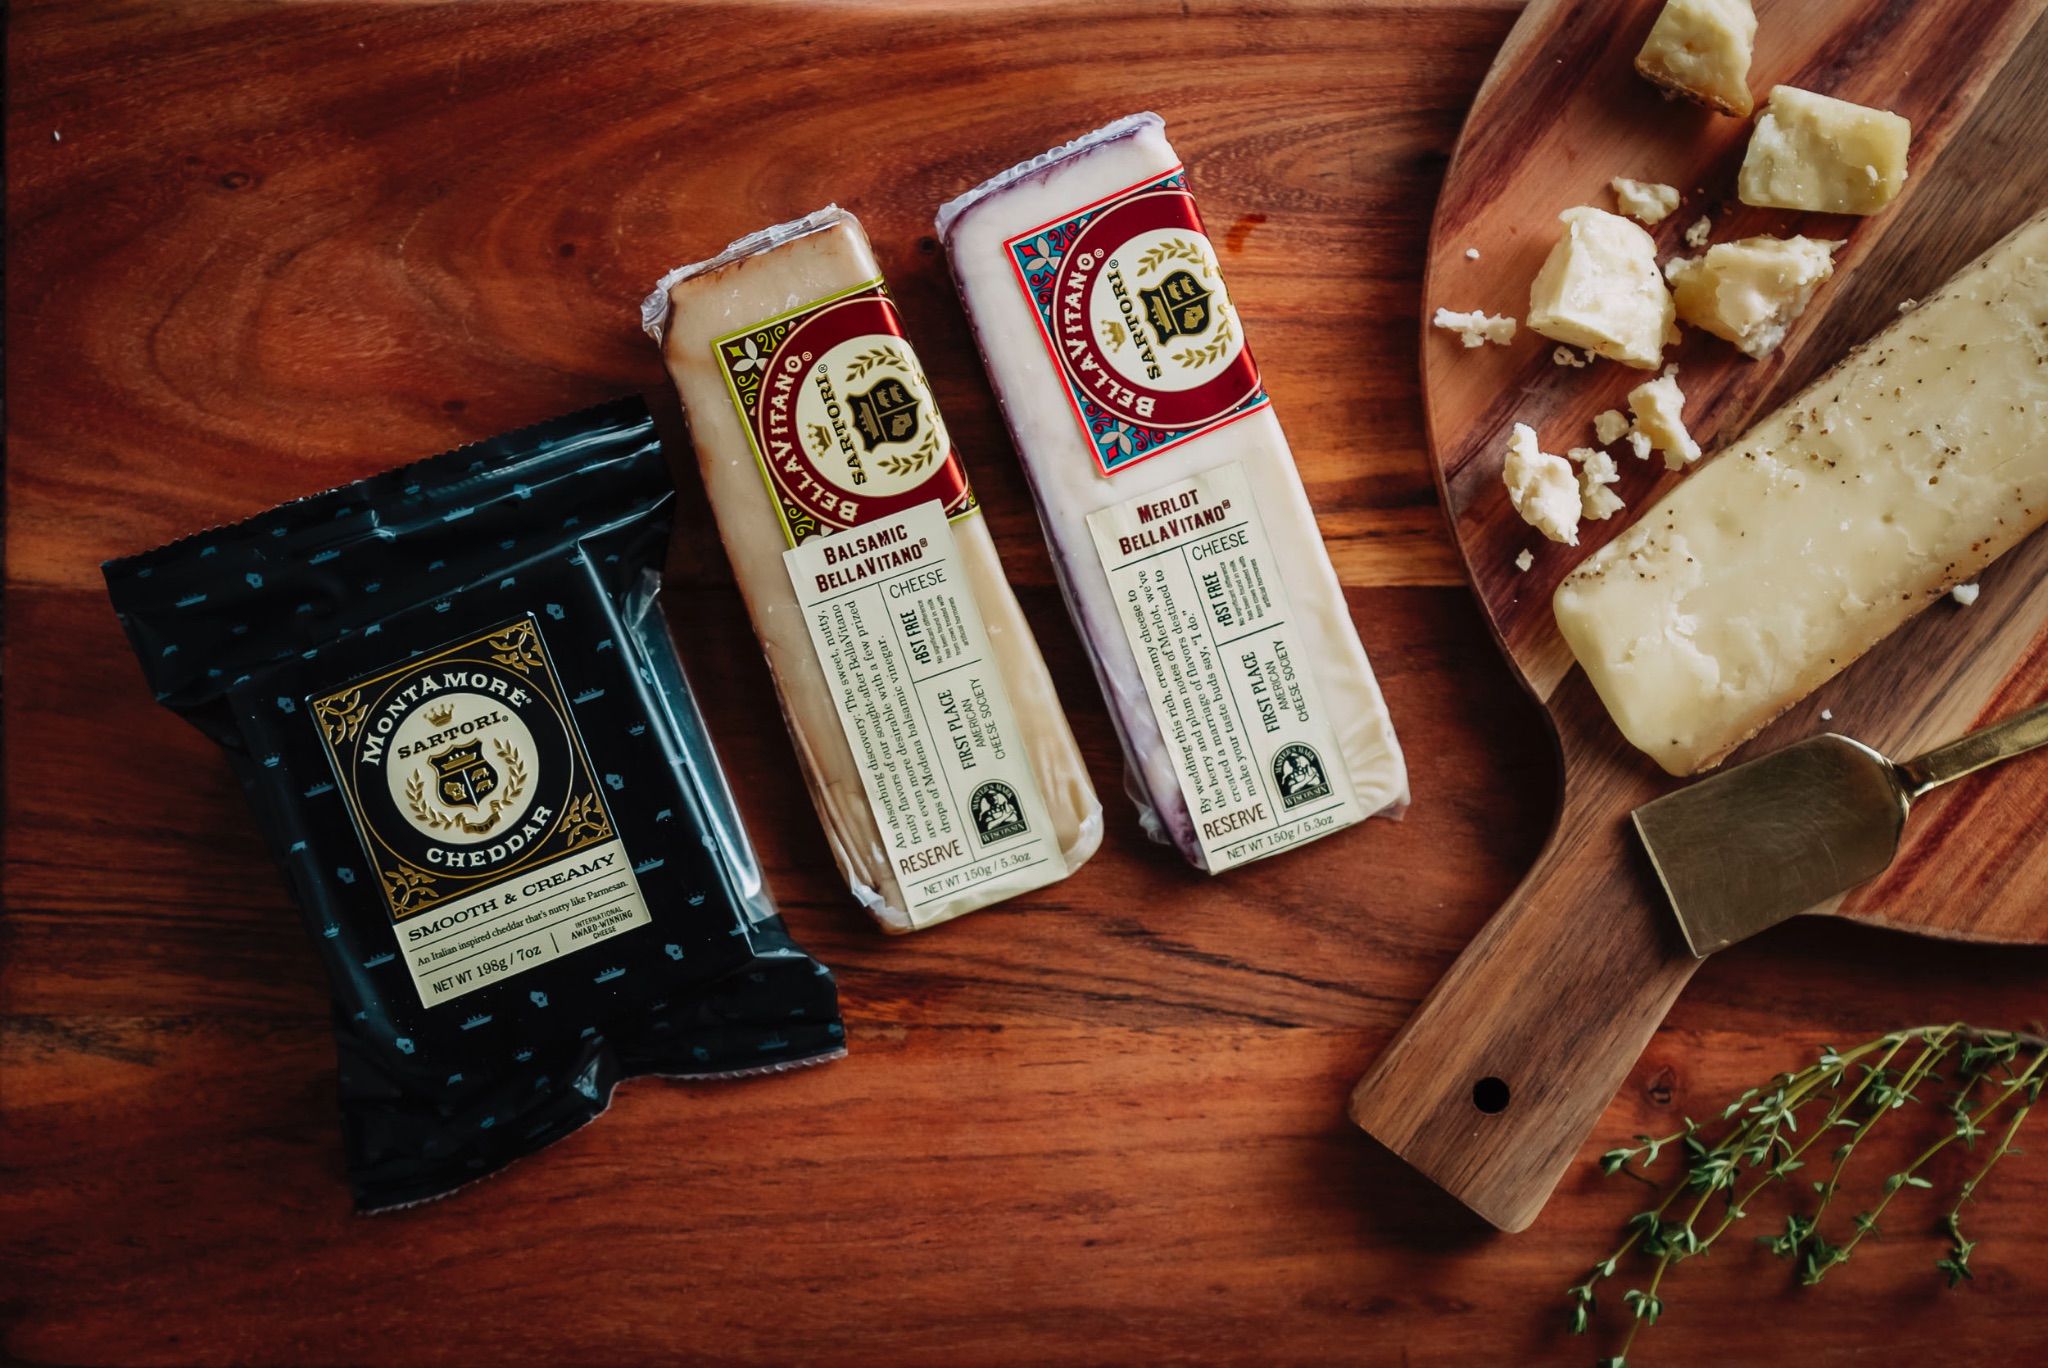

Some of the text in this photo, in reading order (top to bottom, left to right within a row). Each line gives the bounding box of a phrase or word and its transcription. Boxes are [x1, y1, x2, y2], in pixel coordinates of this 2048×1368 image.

[1136, 488, 1199, 524] MERLOT
[823, 524, 908, 566] BALSAMIC
[1191, 529, 1249, 561] CHEESE
[889, 567, 947, 599] CHEESE
[1201, 570, 1234, 626] rBST FREE
[899, 608, 931, 664] rBST FREE
[1149, 603, 1171, 649] Merlot,
[1161, 649, 1175, 661] of
[1199, 645, 1213, 670] say,
[1127, 588, 1212, 814] By wedding this rich, creamy cheese to
[1154, 568, 1241, 802] created a marriage of flavors destined to
[1170, 663, 1187, 695] notes
[1206, 672, 1223, 702] buds
[1240, 650, 1280, 733] FIRST PLACE
[1264, 659, 1290, 710] AMERICAN
[1272, 639, 1309, 722] CHEESE SOCIETY
[817, 609, 907, 848] An absorbing discovery: The sweet, nutty,
[831, 603, 922, 844] fruity flavors of our sought-after BellaVitano
[843, 599, 936, 838] are even more desirable with a few prized
[877, 634, 951, 833] drops of Modena balsamic vinegar.
[937, 688, 976, 769] FIRST PLACE
[960, 697, 986, 747] AMERICAN
[968, 677, 1006, 759] CHEESE SOCIETY
[1182, 696, 1201, 727] plum
[1218, 703, 1234, 733] taste
[1190, 729, 1207, 751] and
[1228, 735, 1247, 762] your
[1202, 755, 1218, 787] berry
[1239, 764, 1256, 796] make
[1214, 788, 1226, 808] the
[426, 805, 552, 867] CHEDDAR
[1202, 802, 1267, 840] RESERVE
[1226, 844, 1246, 860] NET
[1248, 838, 1263, 851] WT
[1266, 829, 1295, 846] 150g
[1303, 815, 1334, 832] 5.3oz
[899, 838, 963, 875] RESERVE
[923, 880, 943, 896] NET
[944, 874, 960, 888] WT
[963, 865, 992, 881] 150g
[1000, 852, 1031, 868] 5.3oz
[408, 852, 615, 942] SMOOTH & CREAMY
[574, 906, 623, 928] INTERNATIONAL
[417, 956, 431, 966] An
[430, 946, 458, 960] Italian
[457, 930, 492, 950] inspired
[491, 919, 524, 937] cheddar
[547, 902, 570, 915] nutty
[569, 896, 587, 907] like
[585, 880, 629, 900] Parmesan.
[571, 909, 633, 940] AWARD-WINNING
[592, 925, 617, 939] CHEESE
[432, 976, 454, 994] NET
[454, 969, 472, 984] WT
[476, 958, 509, 977] 198g
[516, 945, 542, 961] 7oz
